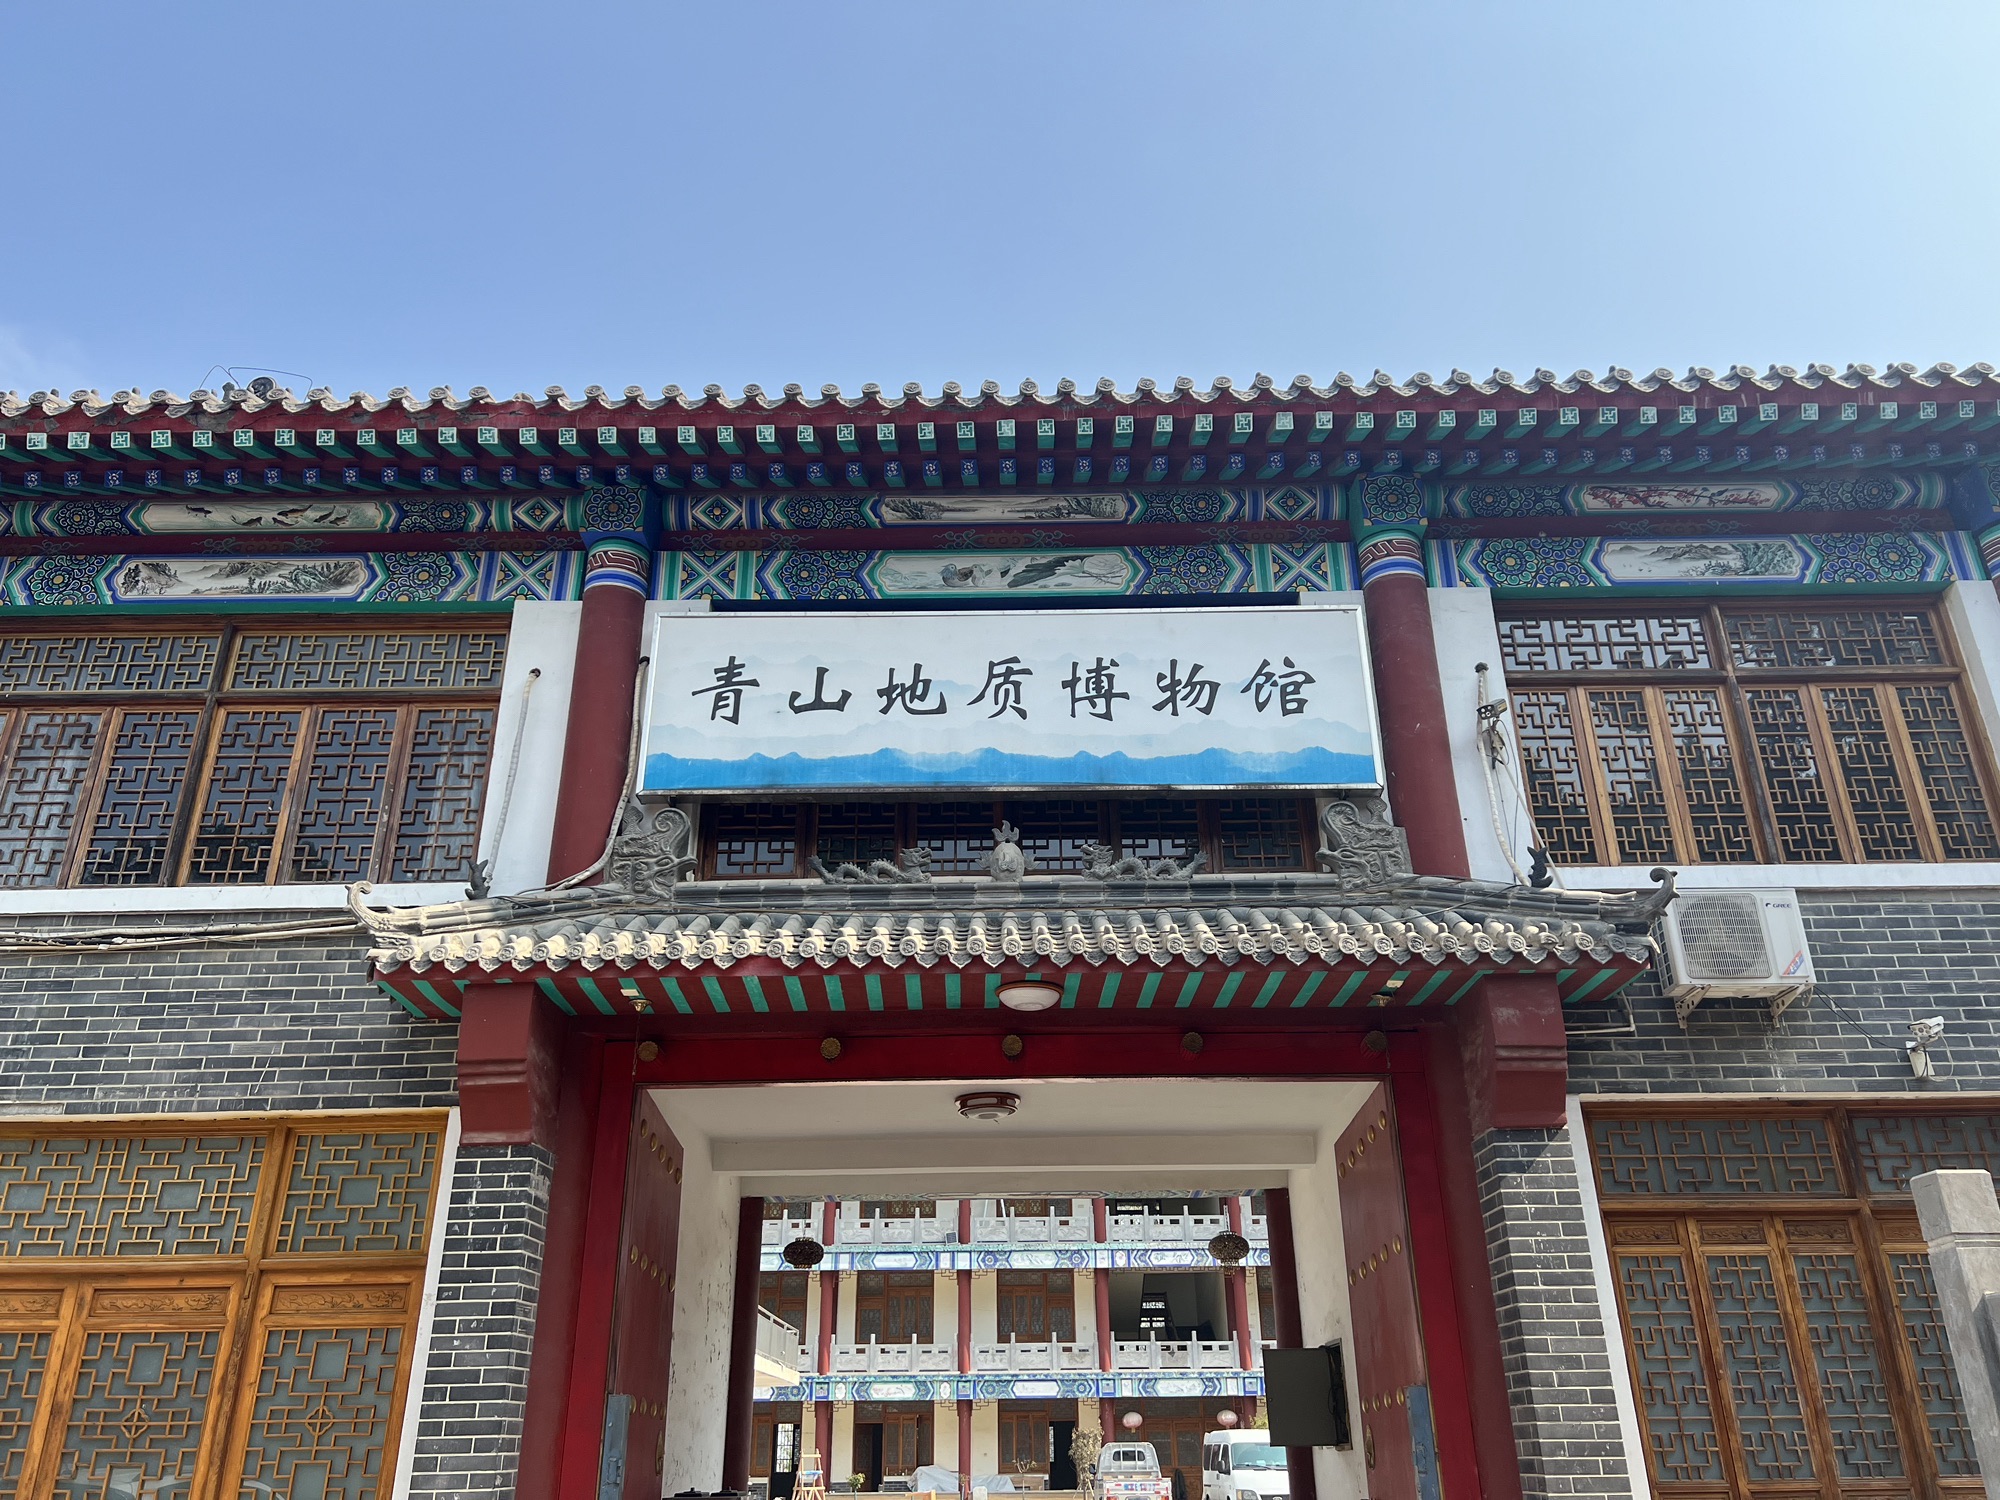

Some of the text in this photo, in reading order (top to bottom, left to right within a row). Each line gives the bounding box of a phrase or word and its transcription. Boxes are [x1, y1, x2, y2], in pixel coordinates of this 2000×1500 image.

[691, 655, 1317, 725] 青山地质博物馆
